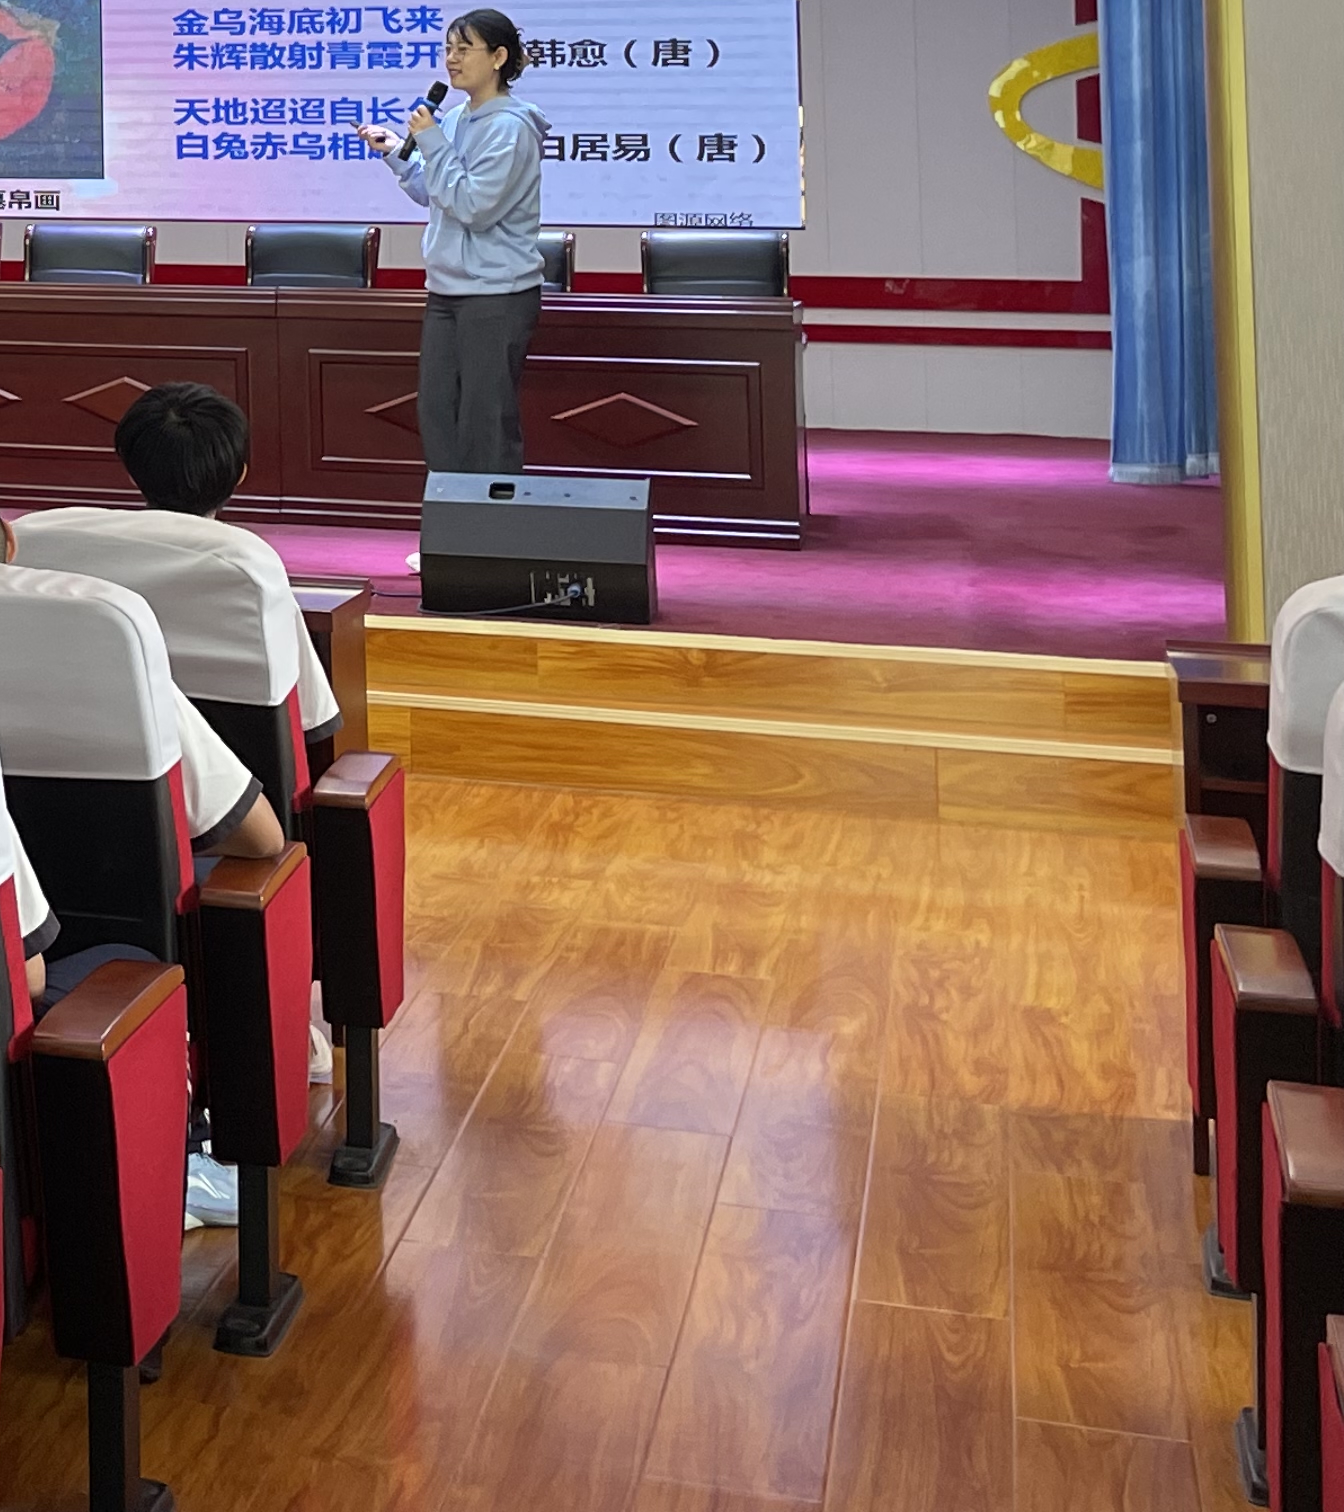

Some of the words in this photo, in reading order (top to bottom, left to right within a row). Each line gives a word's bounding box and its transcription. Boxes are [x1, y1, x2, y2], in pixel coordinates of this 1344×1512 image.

[172, 4, 444, 37] 金乌海底初飞来
[173, 41, 440, 71] 朱辉散射青霞开
[175, 131, 386, 161] 白兔赤乌相
